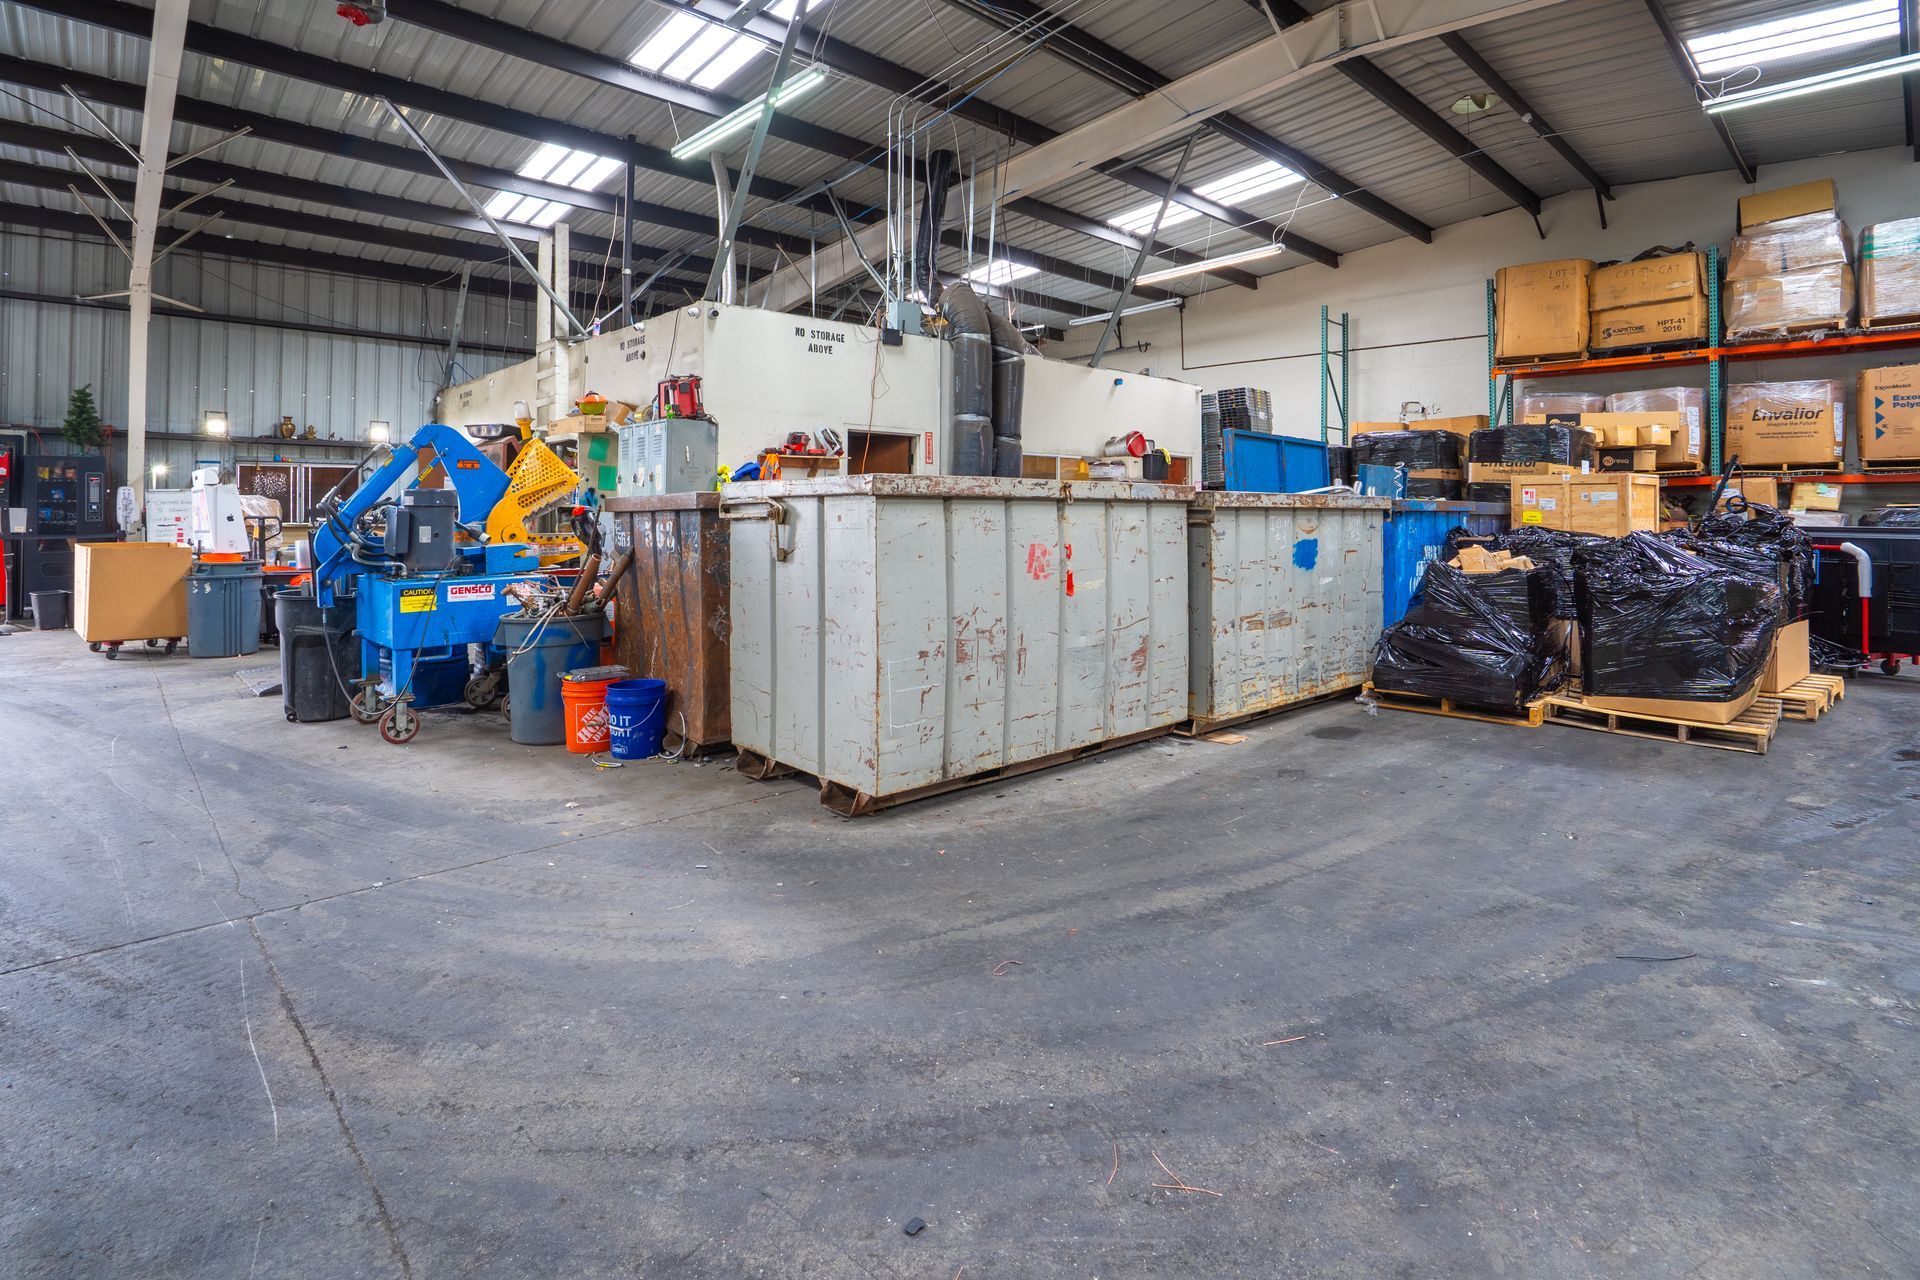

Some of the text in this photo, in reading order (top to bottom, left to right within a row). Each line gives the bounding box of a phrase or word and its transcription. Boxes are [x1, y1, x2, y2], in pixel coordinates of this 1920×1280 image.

[1657, 317, 1686, 327] HPT-41
[795, 326, 845, 343] NO STORAGE
[1662, 325, 1682, 333] 2016
[808, 343, 833, 355] ABOVE
[1751, 407, 1824, 421] Envalior
[403, 588, 434, 596] CAUTION
[450, 584, 492, 594] GENSCO
[581, 707, 598, 723] THE
[619, 714, 632, 727] IT
[577, 704, 610, 743] HOM
